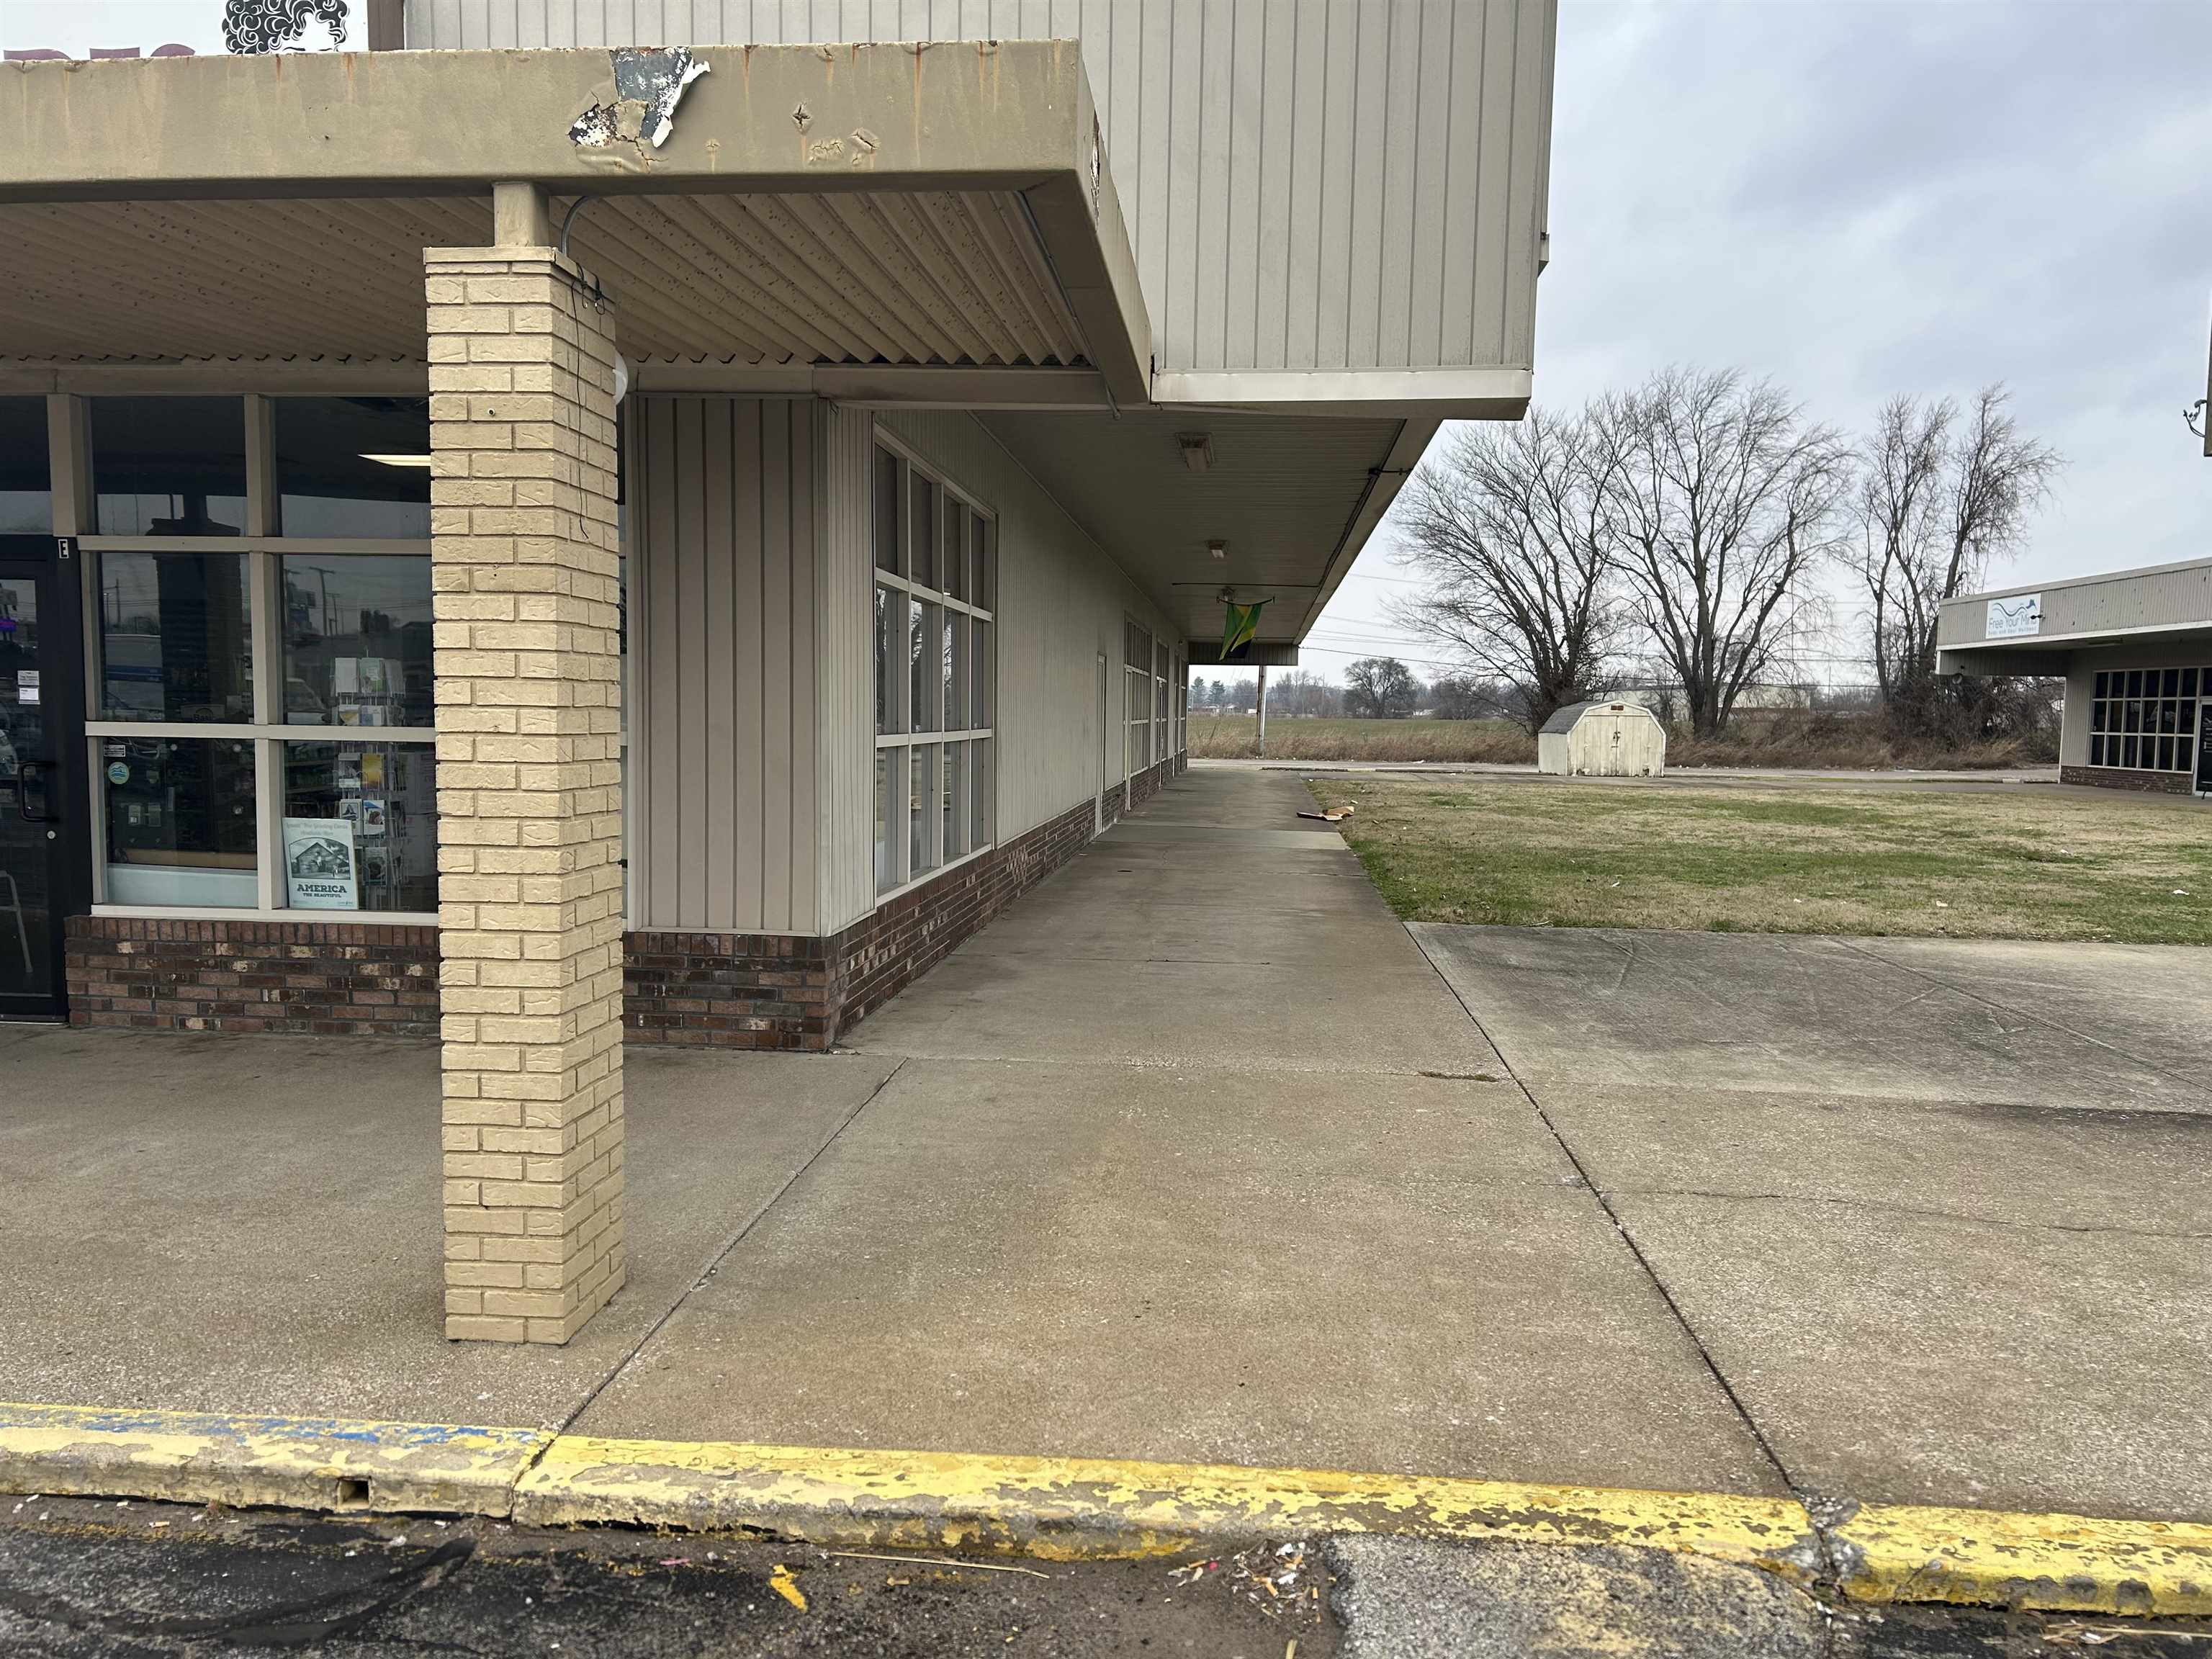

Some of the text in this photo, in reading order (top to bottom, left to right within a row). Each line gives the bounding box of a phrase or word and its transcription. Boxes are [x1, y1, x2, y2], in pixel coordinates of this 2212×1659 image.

[60, 540, 68, 558] E
[1989, 617, 2003, 629] Free
[2005, 616, 2019, 628] Your
[297, 884, 347, 894] AMERICA
